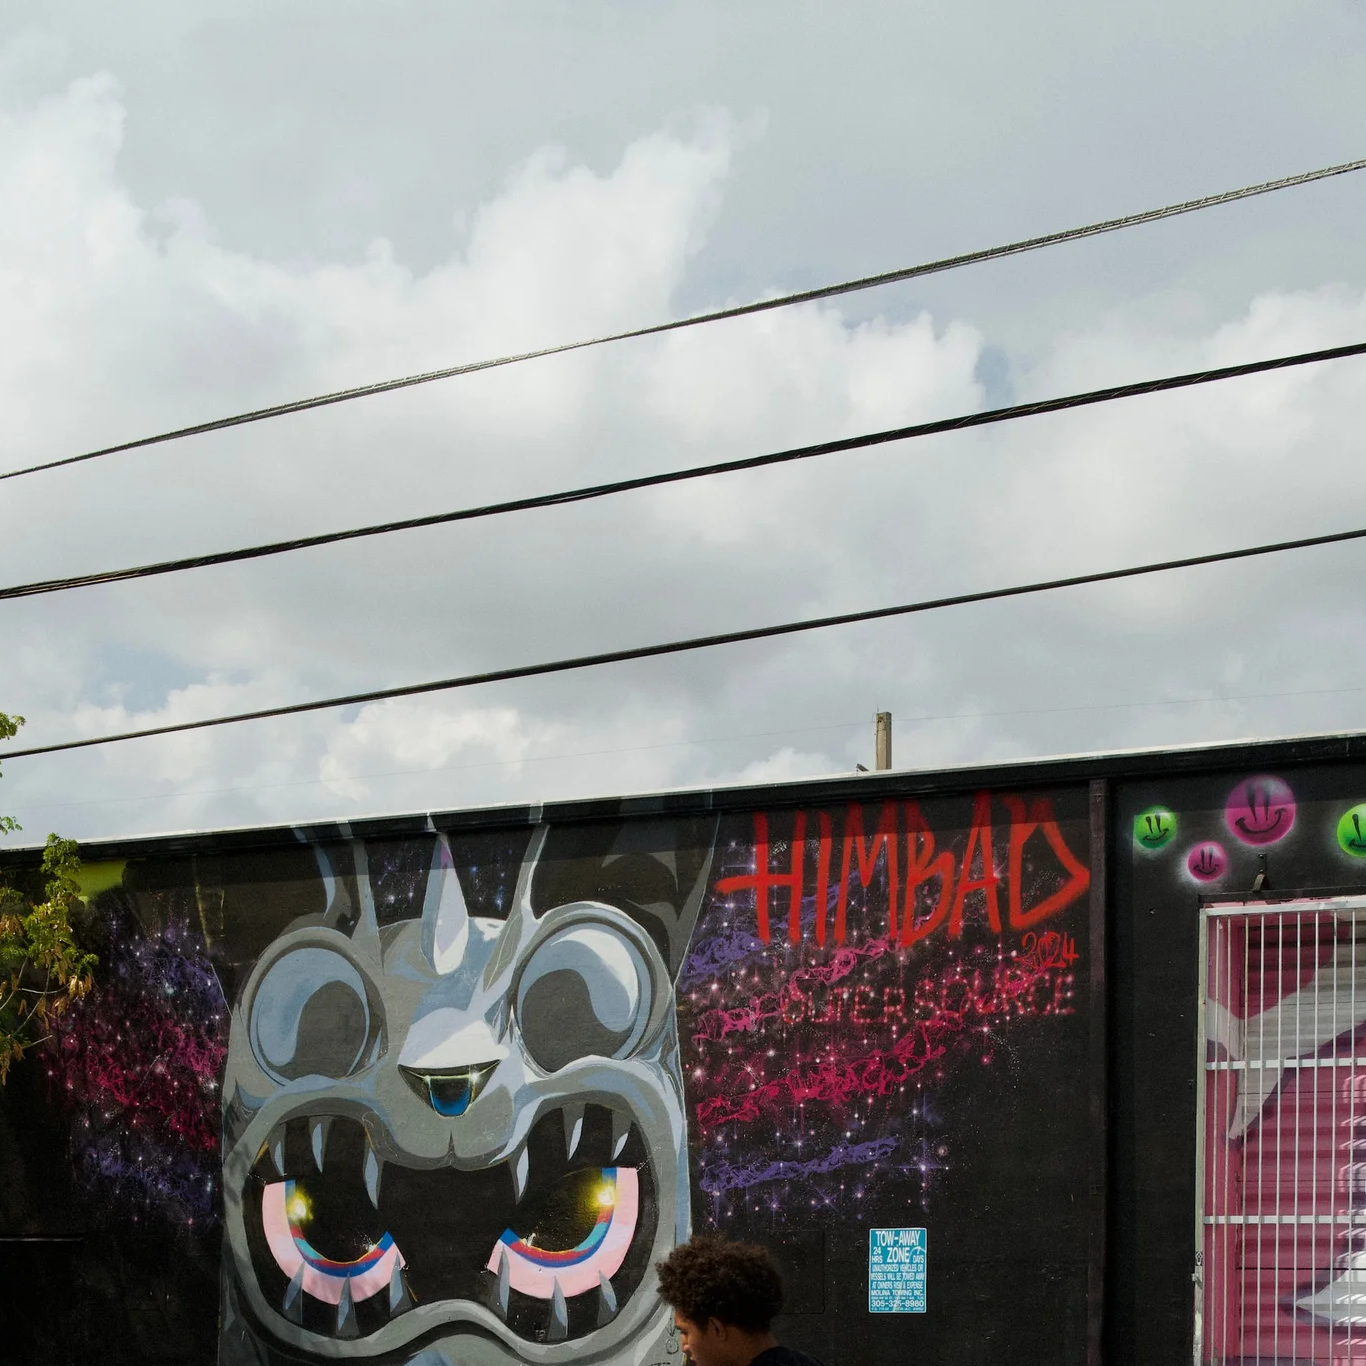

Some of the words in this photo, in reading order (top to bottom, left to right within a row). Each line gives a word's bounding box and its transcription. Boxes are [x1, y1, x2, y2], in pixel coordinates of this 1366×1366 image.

[715, 790, 1090, 948] HIMBAD
[782, 983, 909, 1025] OUTER
[913, 972, 1076, 1026] SOURCE
[875, 1230, 921, 1247] TOW-AWAY
[871, 1255, 883, 1264] HRS
[913, 1255, 924, 1264] DAYS
[873, 1246, 882, 1255] 24
[886, 1247, 911, 1263] ZONE
